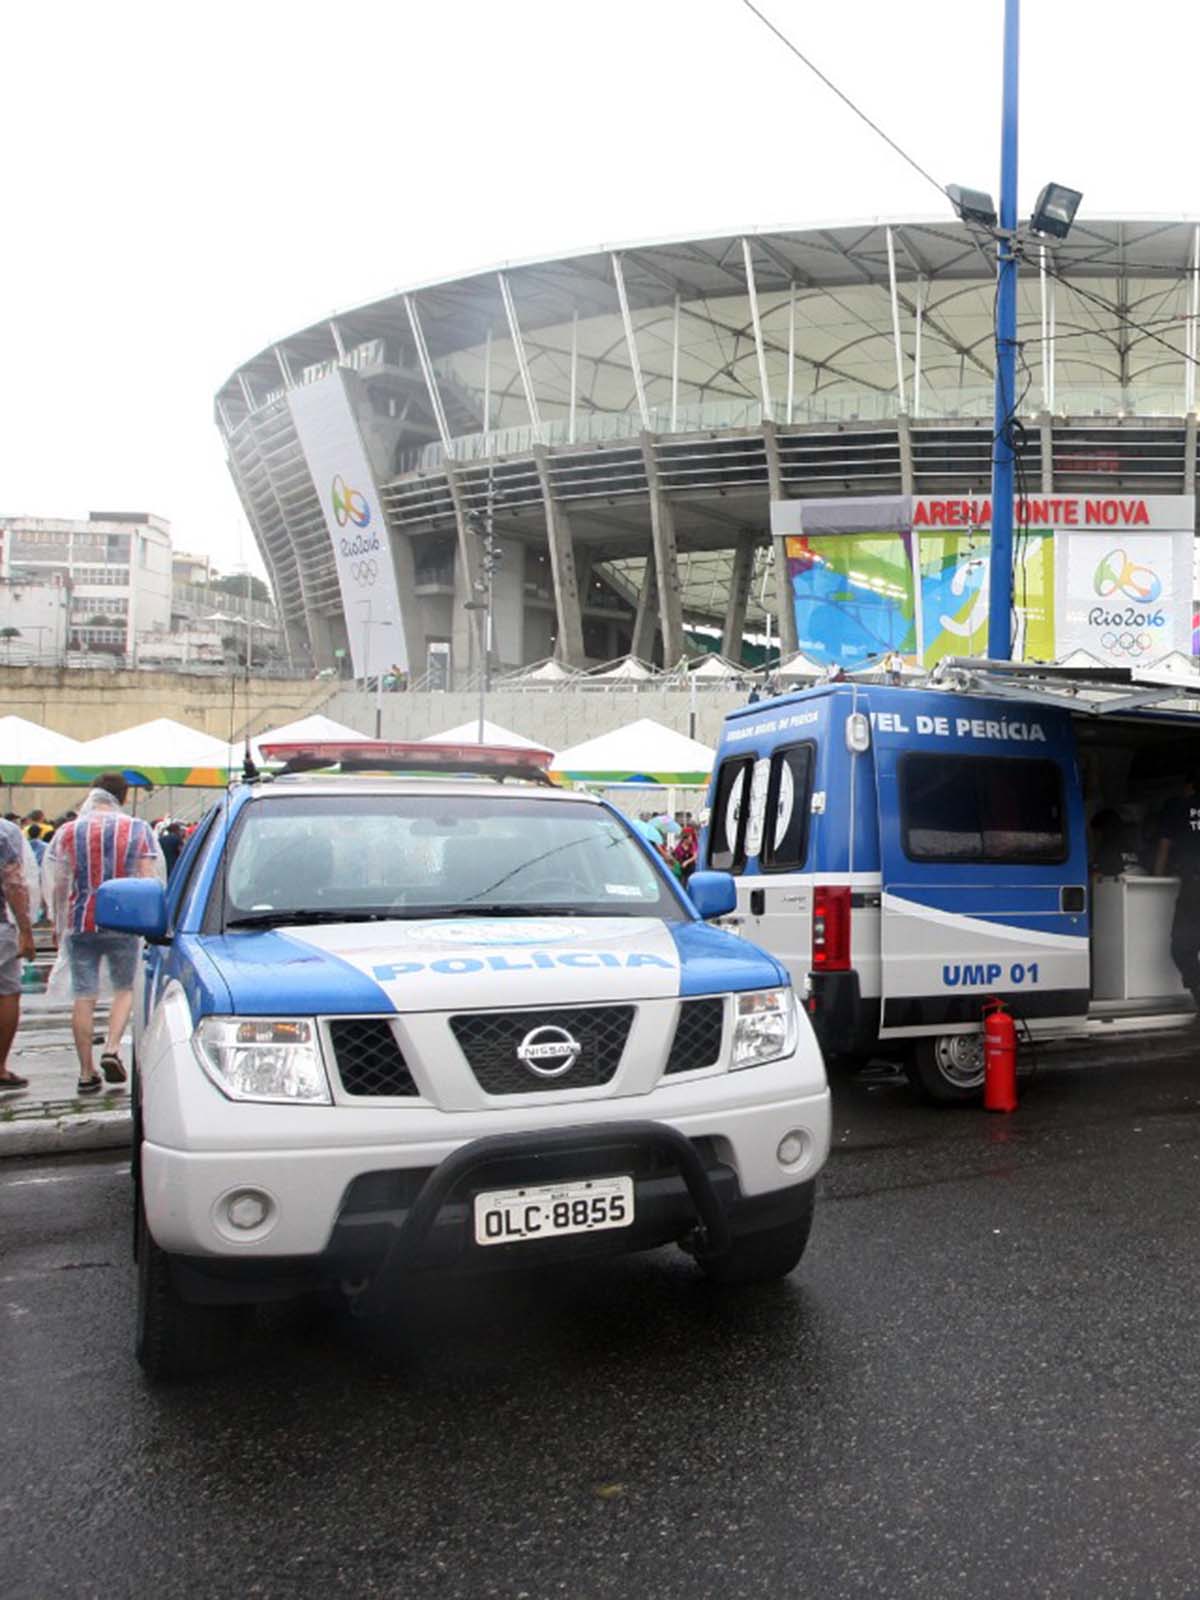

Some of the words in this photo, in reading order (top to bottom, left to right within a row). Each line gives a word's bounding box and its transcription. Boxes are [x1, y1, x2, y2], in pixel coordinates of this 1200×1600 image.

[913, 499, 992, 526] ARENA
[1015, 499, 1079, 525] ONTE
[1085, 499, 1150, 525] NOVA
[916, 715, 950, 736] DE
[955, 715, 1047, 742] PERÍCIA
[371, 951, 680, 982] POLÍCIA
[943, 963, 1002, 987] UMP
[1010, 962, 1040, 984] 01
[523, 1044, 579, 1057] NISSAN
